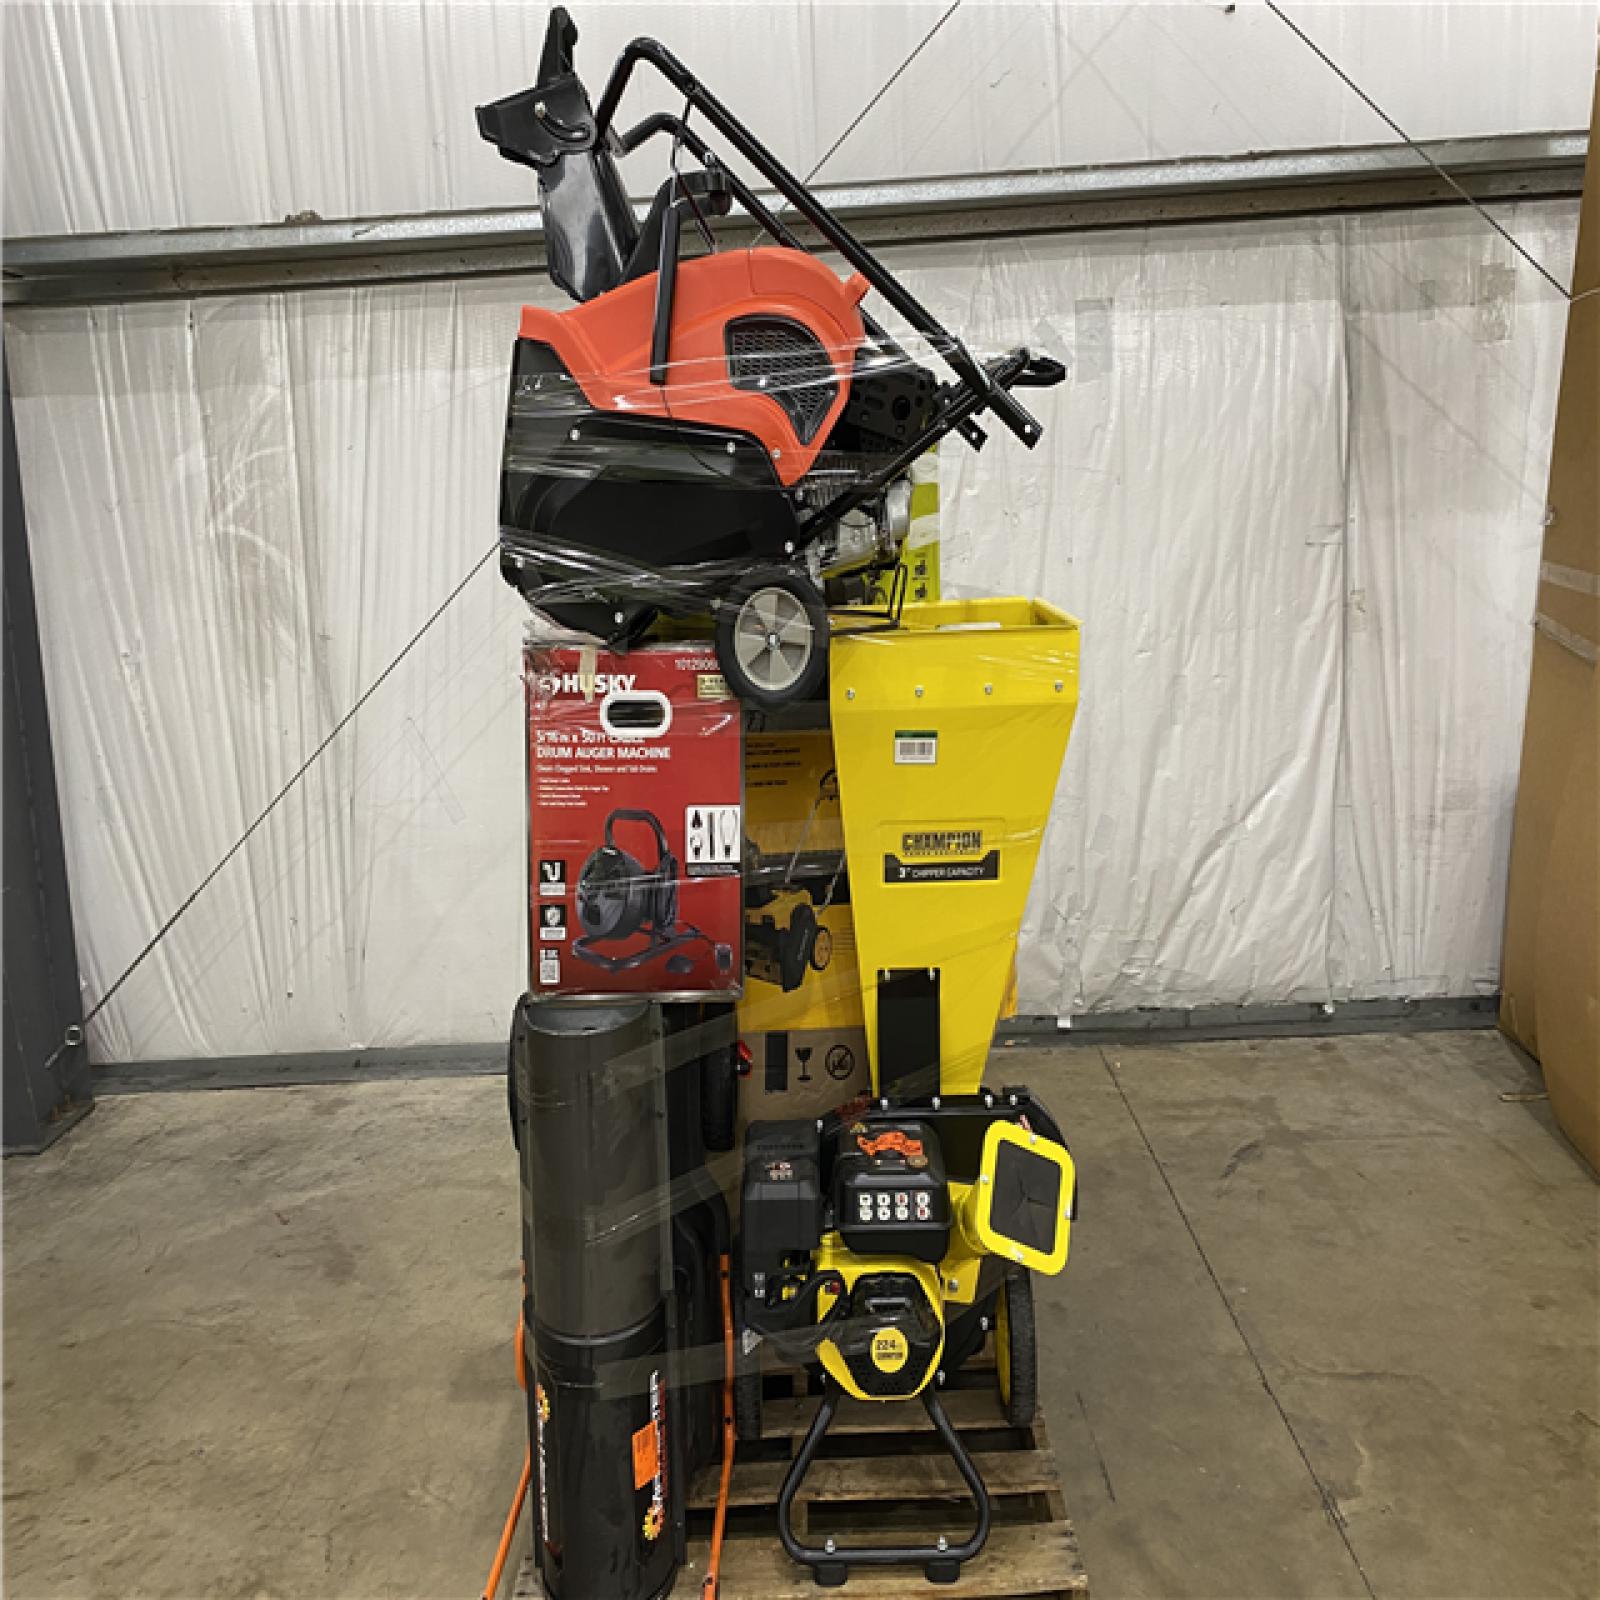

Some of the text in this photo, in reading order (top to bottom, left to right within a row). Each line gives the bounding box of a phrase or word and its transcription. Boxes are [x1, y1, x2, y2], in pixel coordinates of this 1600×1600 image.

[562, 674, 636, 693] HUSKY
[537, 747, 671, 759] DRUM AUGER MACHINE
[903, 830, 981, 850] CHAMPION
